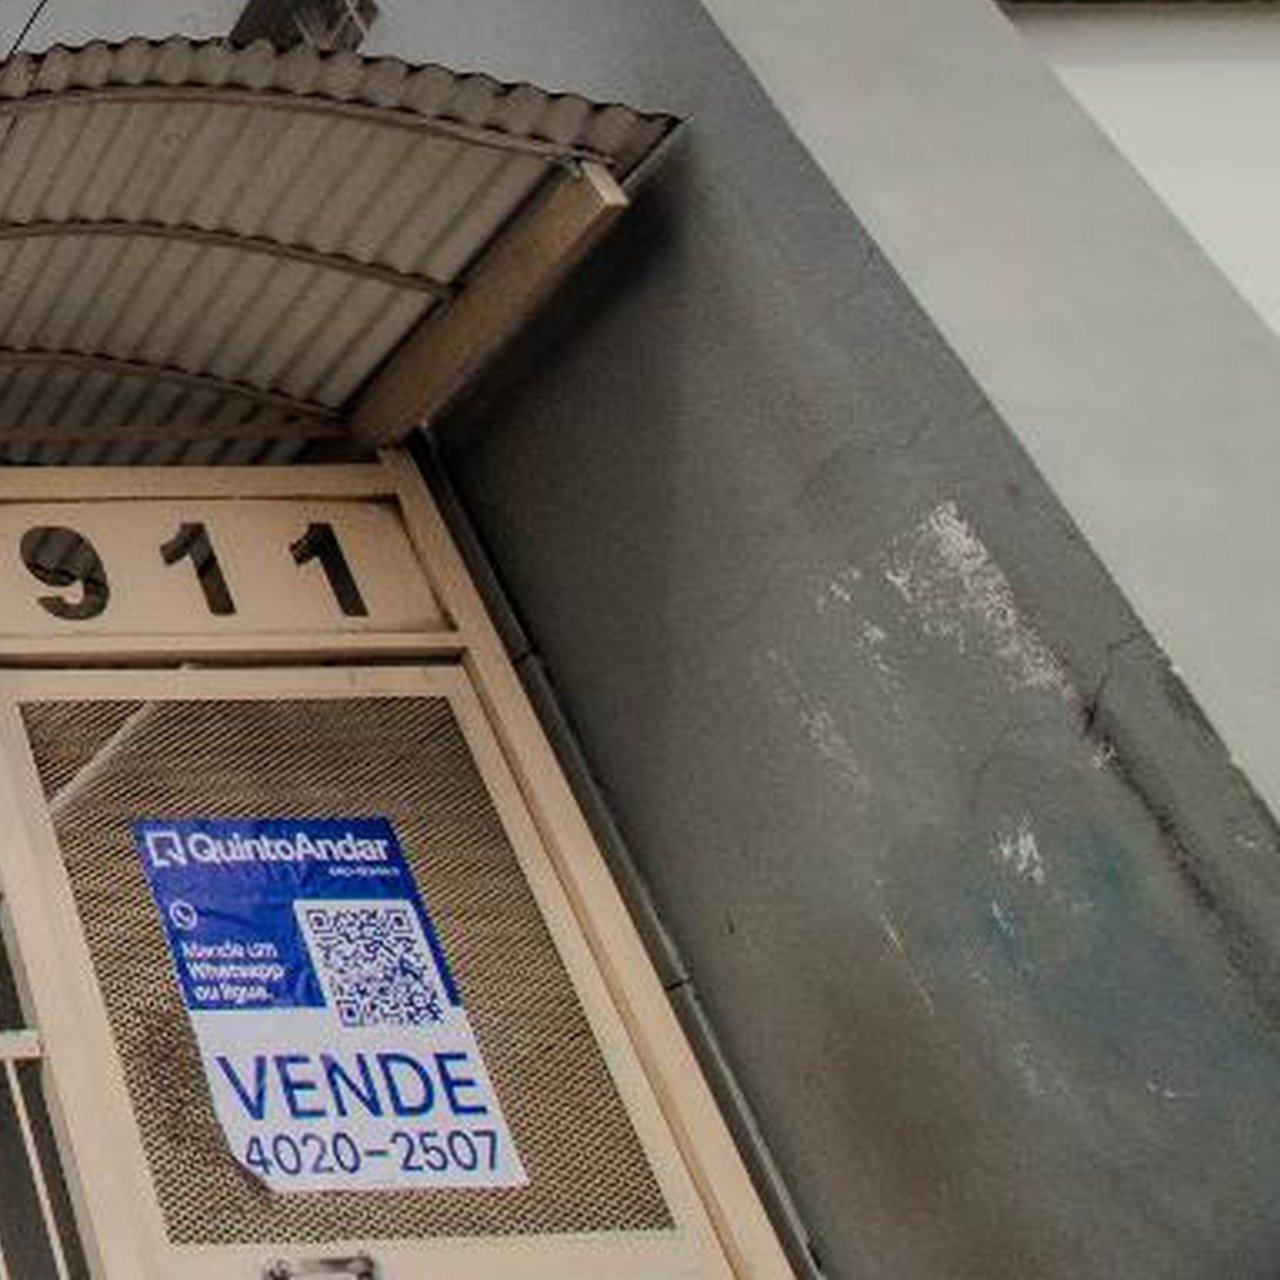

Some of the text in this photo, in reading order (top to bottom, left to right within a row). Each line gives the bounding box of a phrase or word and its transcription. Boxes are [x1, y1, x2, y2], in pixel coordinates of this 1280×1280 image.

[20, 522, 369, 620] 911
[189, 832, 389, 863] QuintoAndar
[215, 1051, 489, 1120] VENDE
[245, 1130, 497, 1175] 4020-2507
